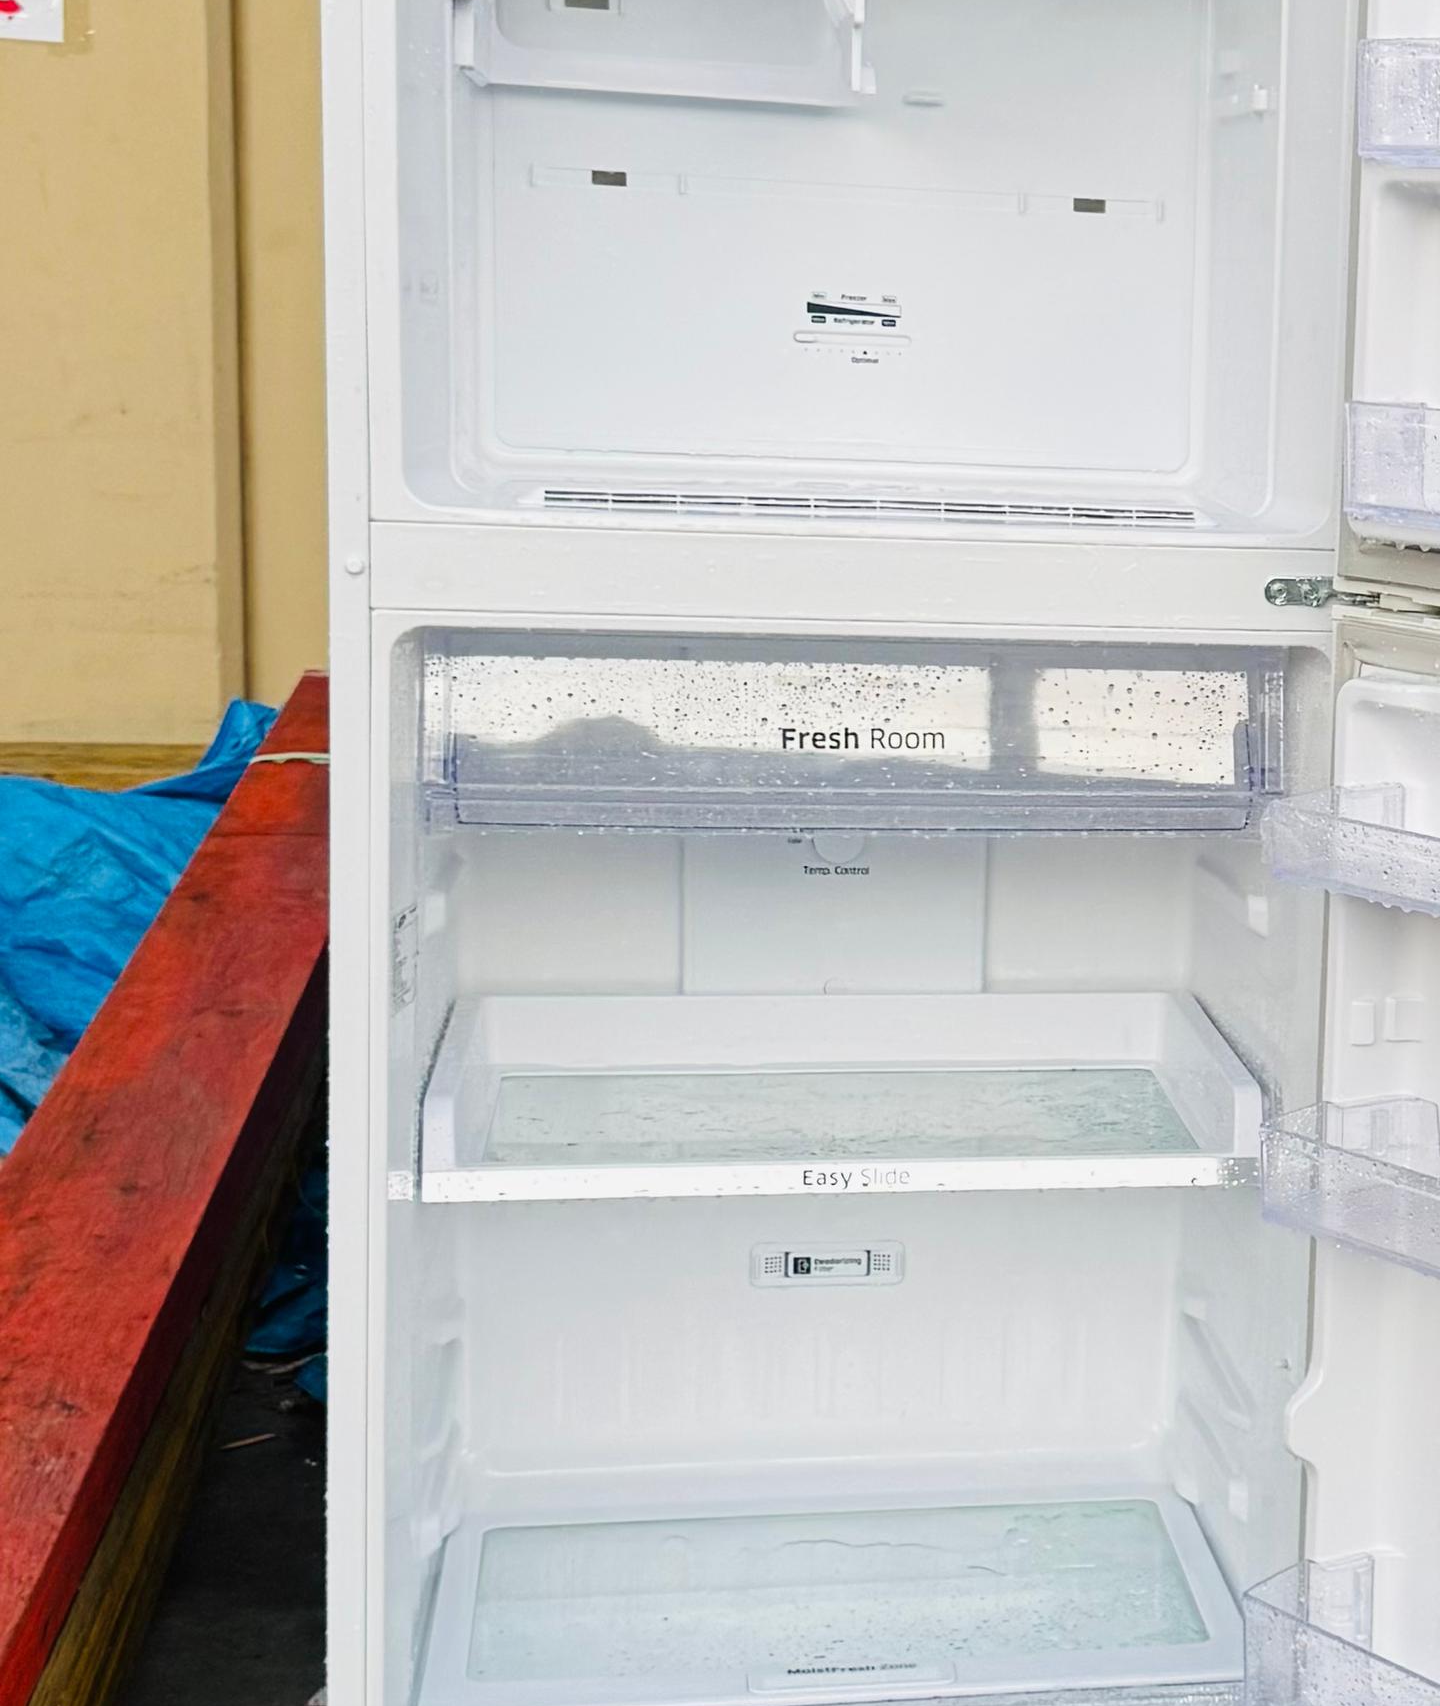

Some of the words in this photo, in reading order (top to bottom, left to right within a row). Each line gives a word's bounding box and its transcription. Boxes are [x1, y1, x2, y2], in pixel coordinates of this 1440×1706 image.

[781, 727, 859, 749] Fresh
[871, 727, 945, 749] Room
[834, 865, 870, 875] Control
[802, 1169, 852, 1189] Easy
[860, 1168, 911, 1187] Slide
